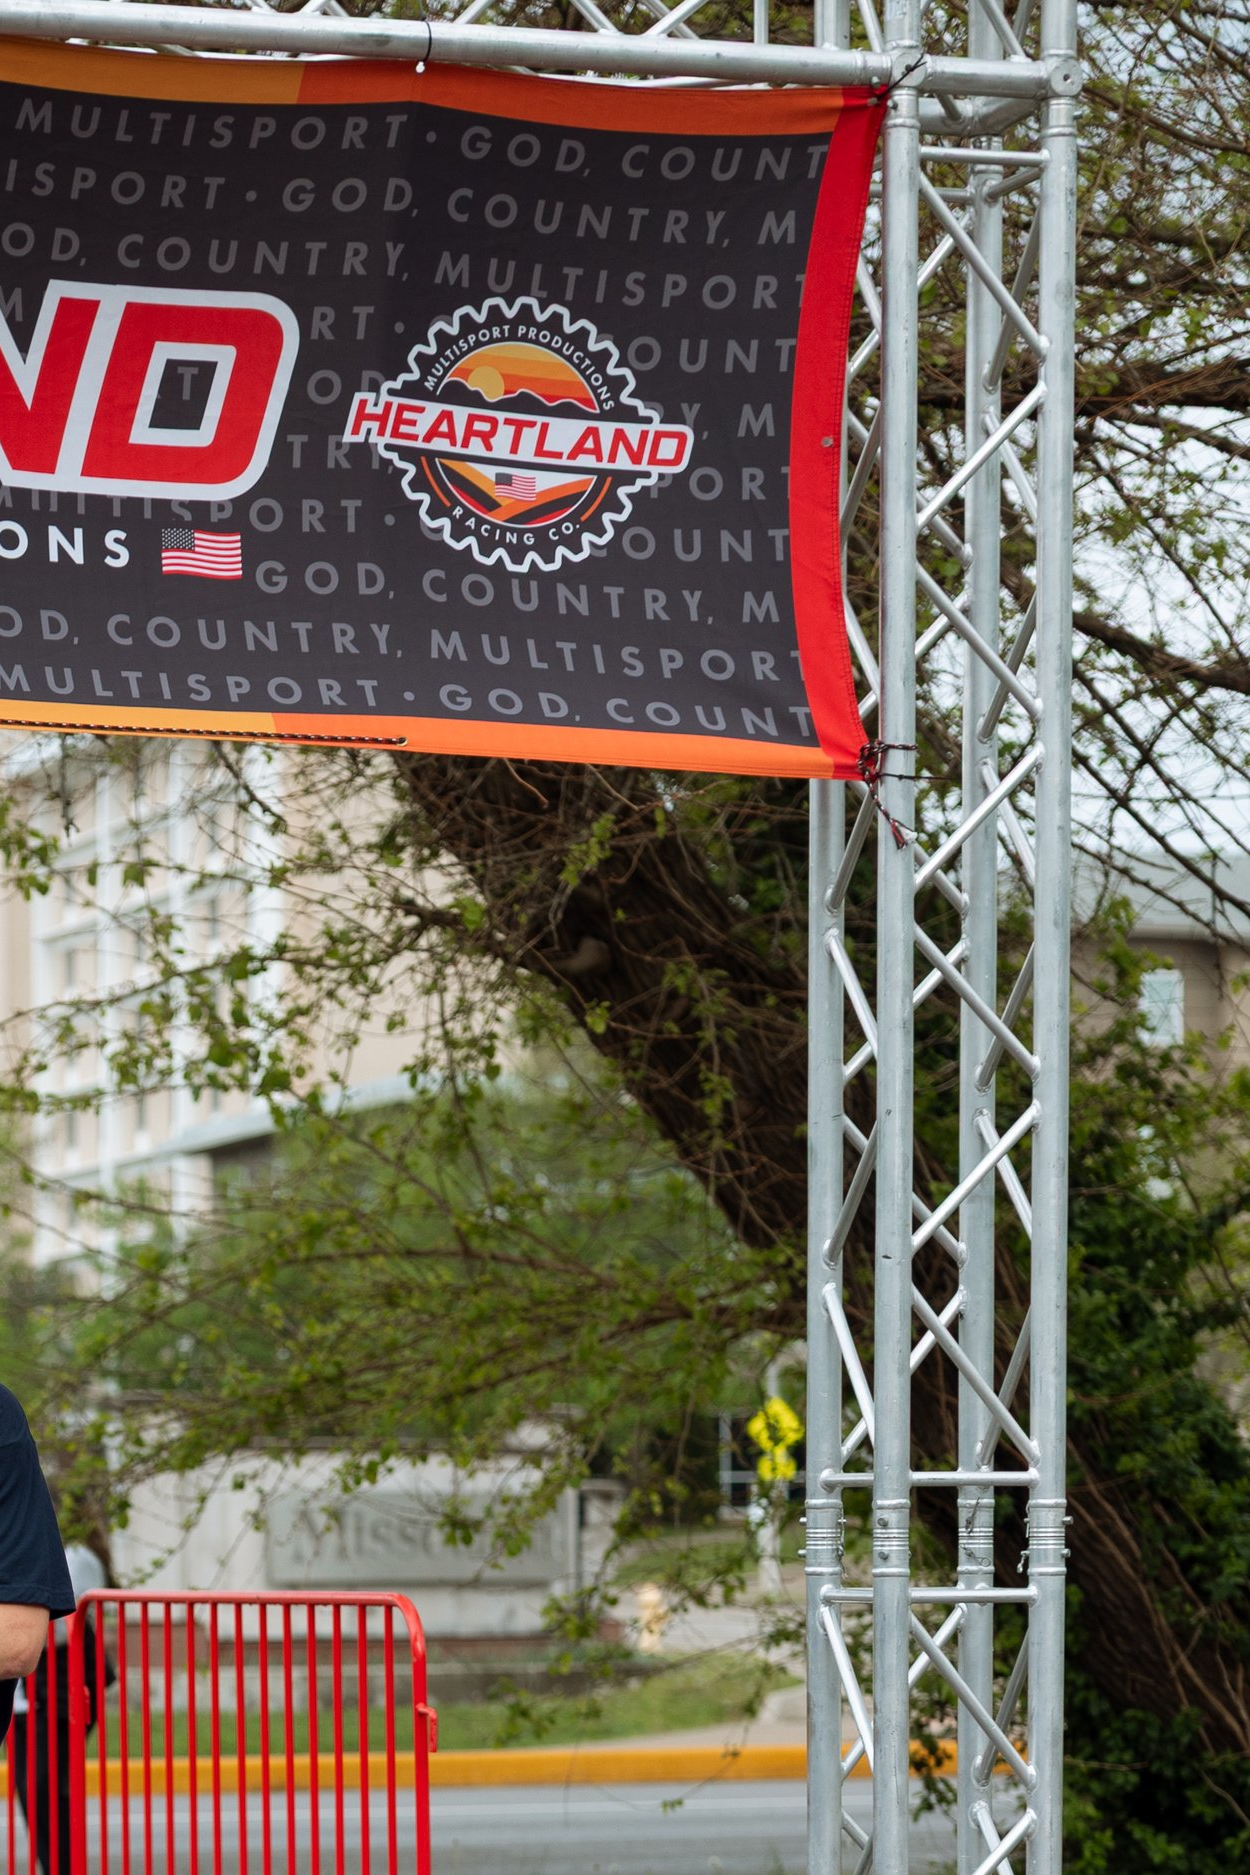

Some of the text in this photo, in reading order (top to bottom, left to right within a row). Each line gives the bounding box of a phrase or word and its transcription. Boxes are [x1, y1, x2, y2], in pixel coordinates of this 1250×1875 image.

[15, 98, 407, 149] MULTISPORT
[621, 145, 829, 181] COUNT
[424, 325, 510, 391] MULTISPORT
[518, 325, 614, 411] PRODUCTIONS
[597, 334, 796, 373] OUNT
[349, 397, 689, 470] HEARTLAND
[453, 506, 581, 544] RACING CO.
[591, 526, 789, 562] OUNT
[606, 698, 811, 736] COUNT
